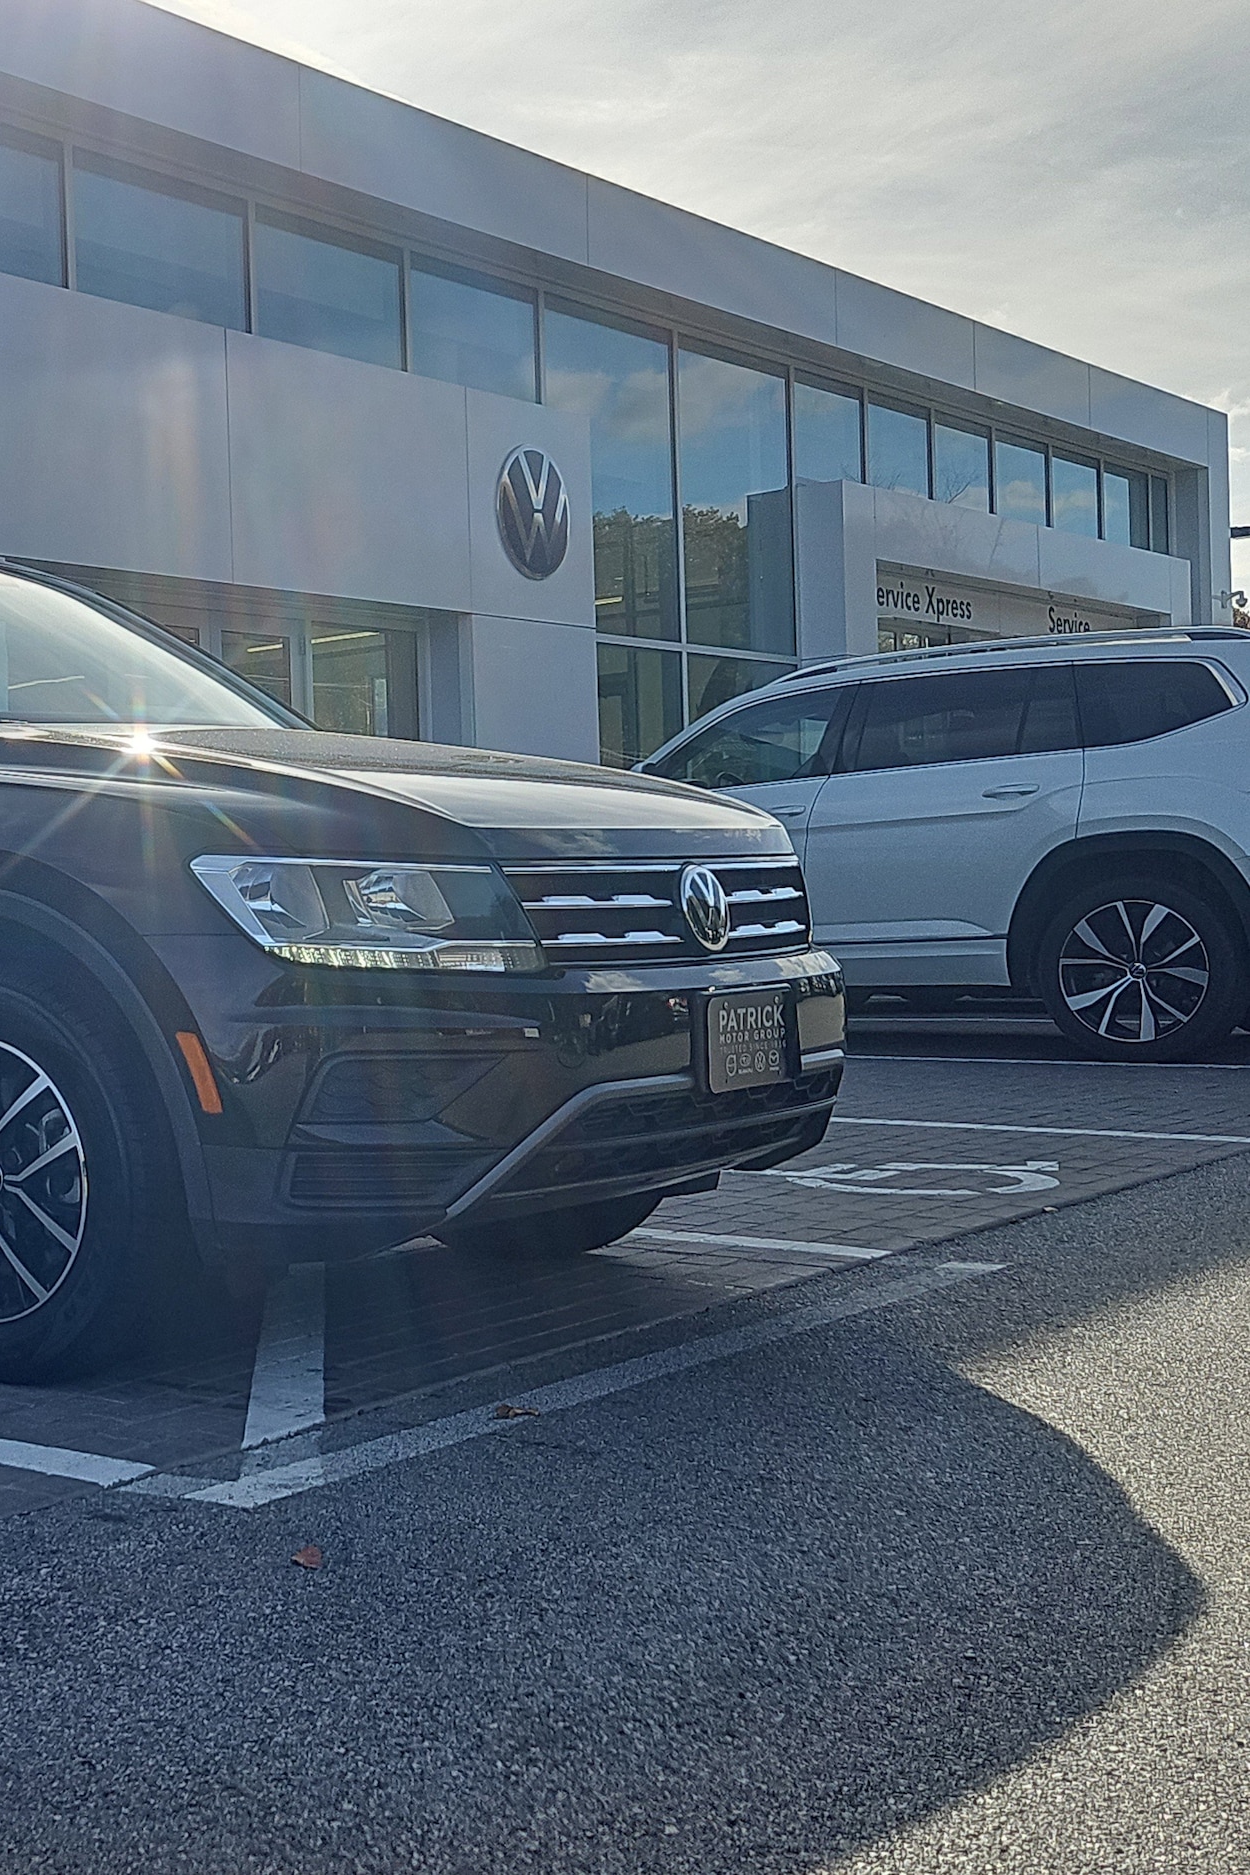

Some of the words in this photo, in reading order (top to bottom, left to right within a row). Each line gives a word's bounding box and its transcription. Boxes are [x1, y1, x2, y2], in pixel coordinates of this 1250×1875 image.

[876, 582, 920, 612] ervice
[925, 585, 972, 622] Xpress
[719, 1003, 786, 1034] PATRICK
[719, 1030, 750, 1046] MOTOR
[753, 1026, 786, 1041] GROUP
